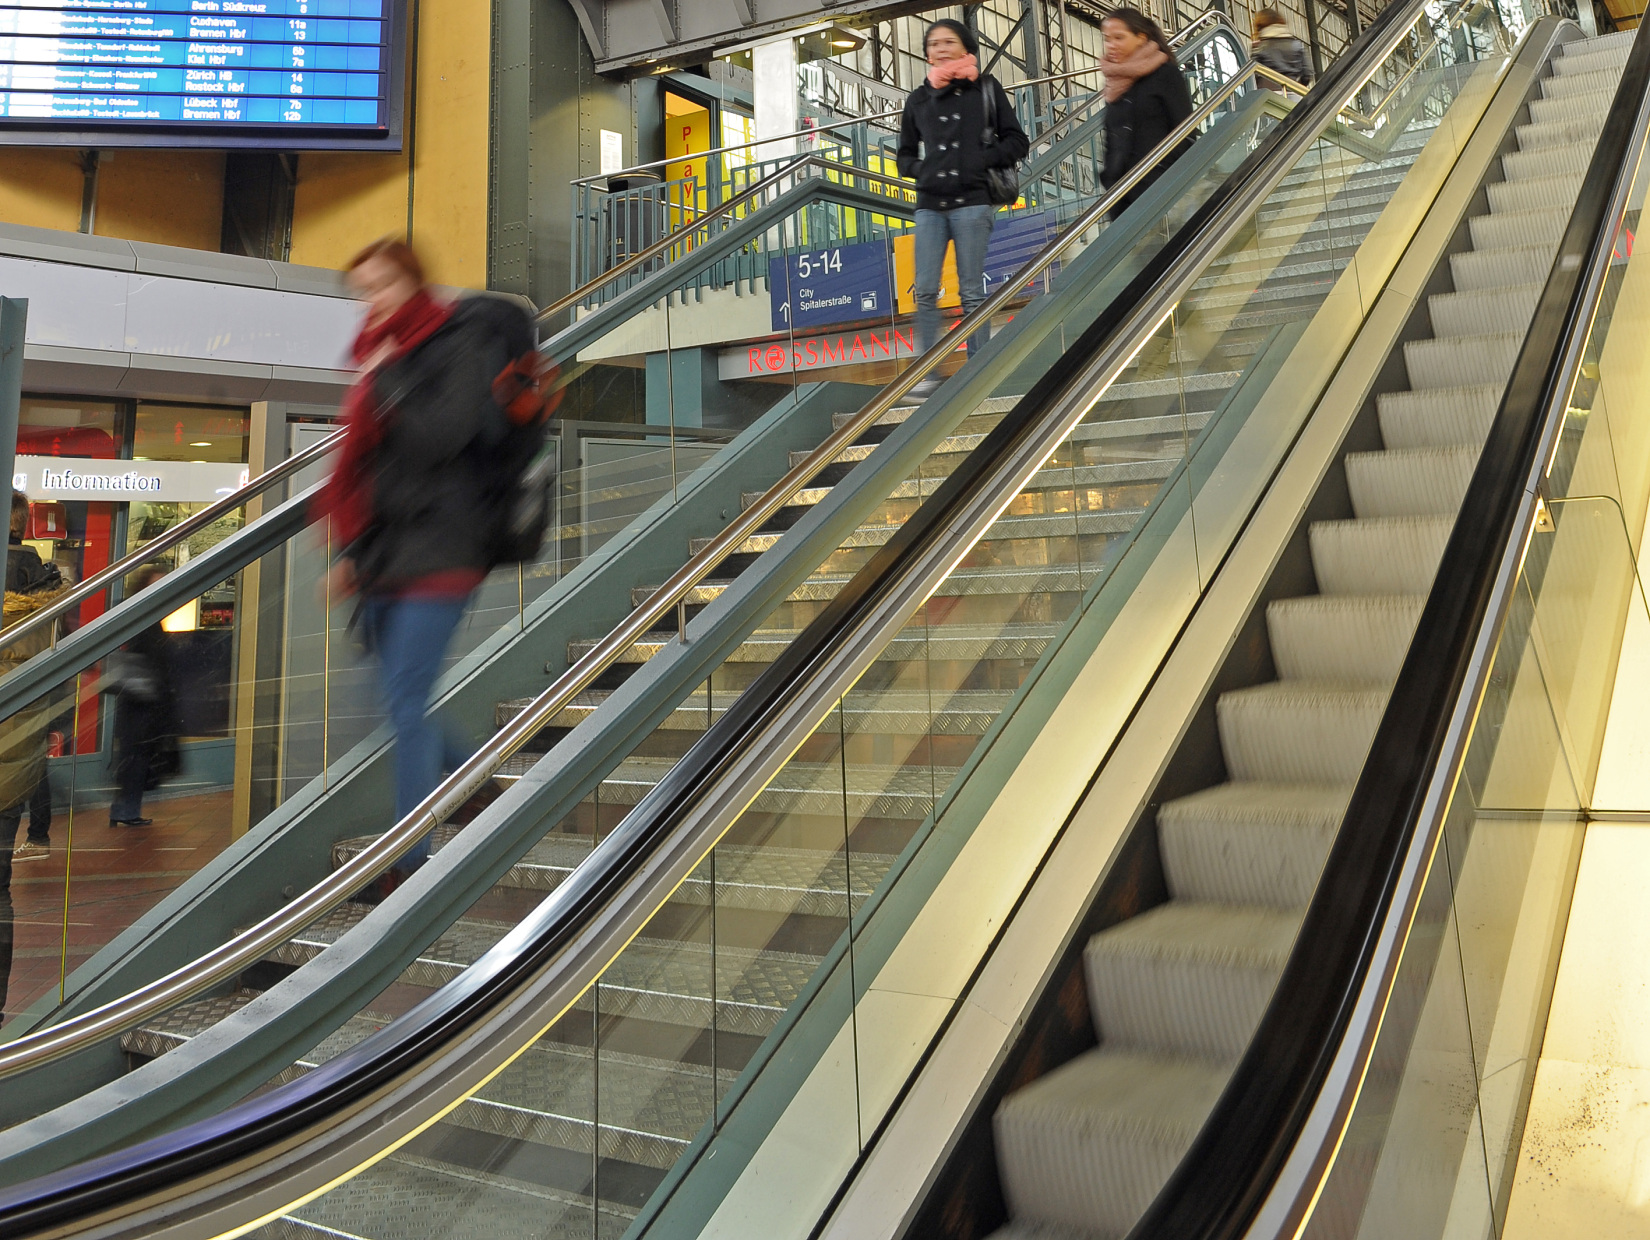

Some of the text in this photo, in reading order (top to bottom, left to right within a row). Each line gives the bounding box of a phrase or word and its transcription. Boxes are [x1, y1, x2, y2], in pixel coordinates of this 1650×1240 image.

[192, 0, 220, 11] Berlin
[222, 2, 267, 12] Südkreuz
[190, 16, 306, 30] Cuxhaven 11a
[190, 27, 306, 40] Bremen Hbf 13
[188, 43, 244, 56] Ahrensburg
[188, 54, 304, 67] Kiel Hbf 7a
[186, 70, 303, 82] Zürich HB 14
[185, 81, 224, 92] Rostock
[228, 82, 245, 92] Hbf
[184, 97, 218, 108] Lübeck
[222, 98, 238, 108] Hbf
[290, 100, 302, 110] 7b
[183, 109, 301, 121] Bremen Hbf 12b
[799, 248, 842, 278] 5-14
[800, 288, 814, 299] City
[800, 295, 852, 312] Spitalerstraße
[748, 327, 914, 373] ROSSMANN
[42, 469, 162, 491] Information
